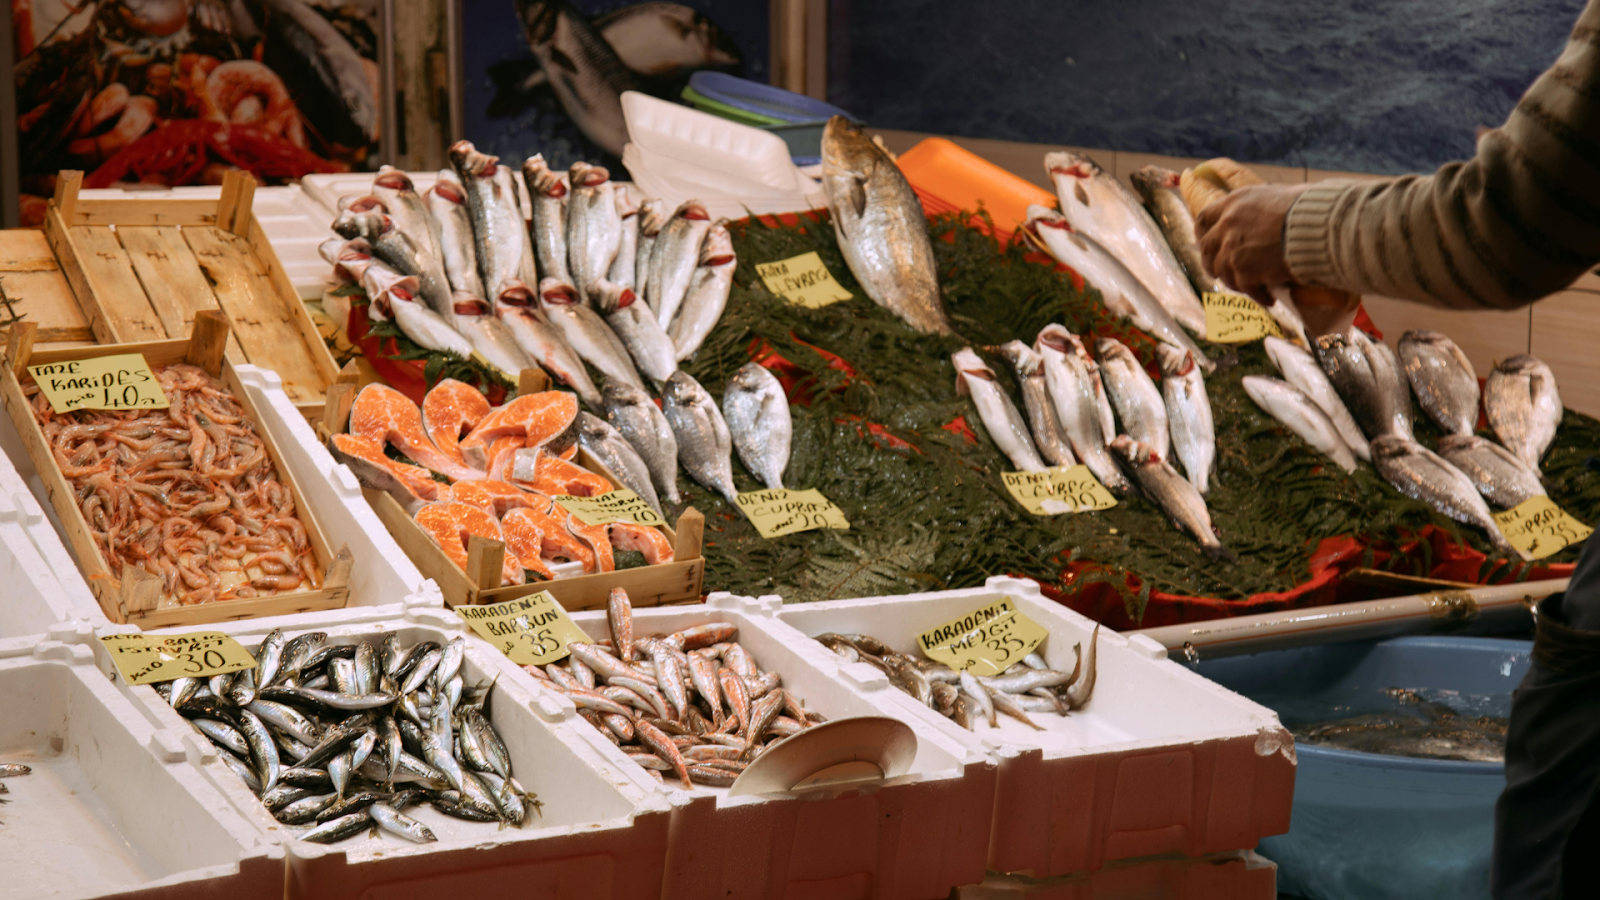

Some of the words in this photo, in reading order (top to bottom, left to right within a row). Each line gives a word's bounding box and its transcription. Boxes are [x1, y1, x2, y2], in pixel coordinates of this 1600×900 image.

[33, 362, 82, 376] TAZE
[520, 628, 560, 657] 35
[986, 633, 1025, 662] 35
[176, 649, 226, 673] 30
